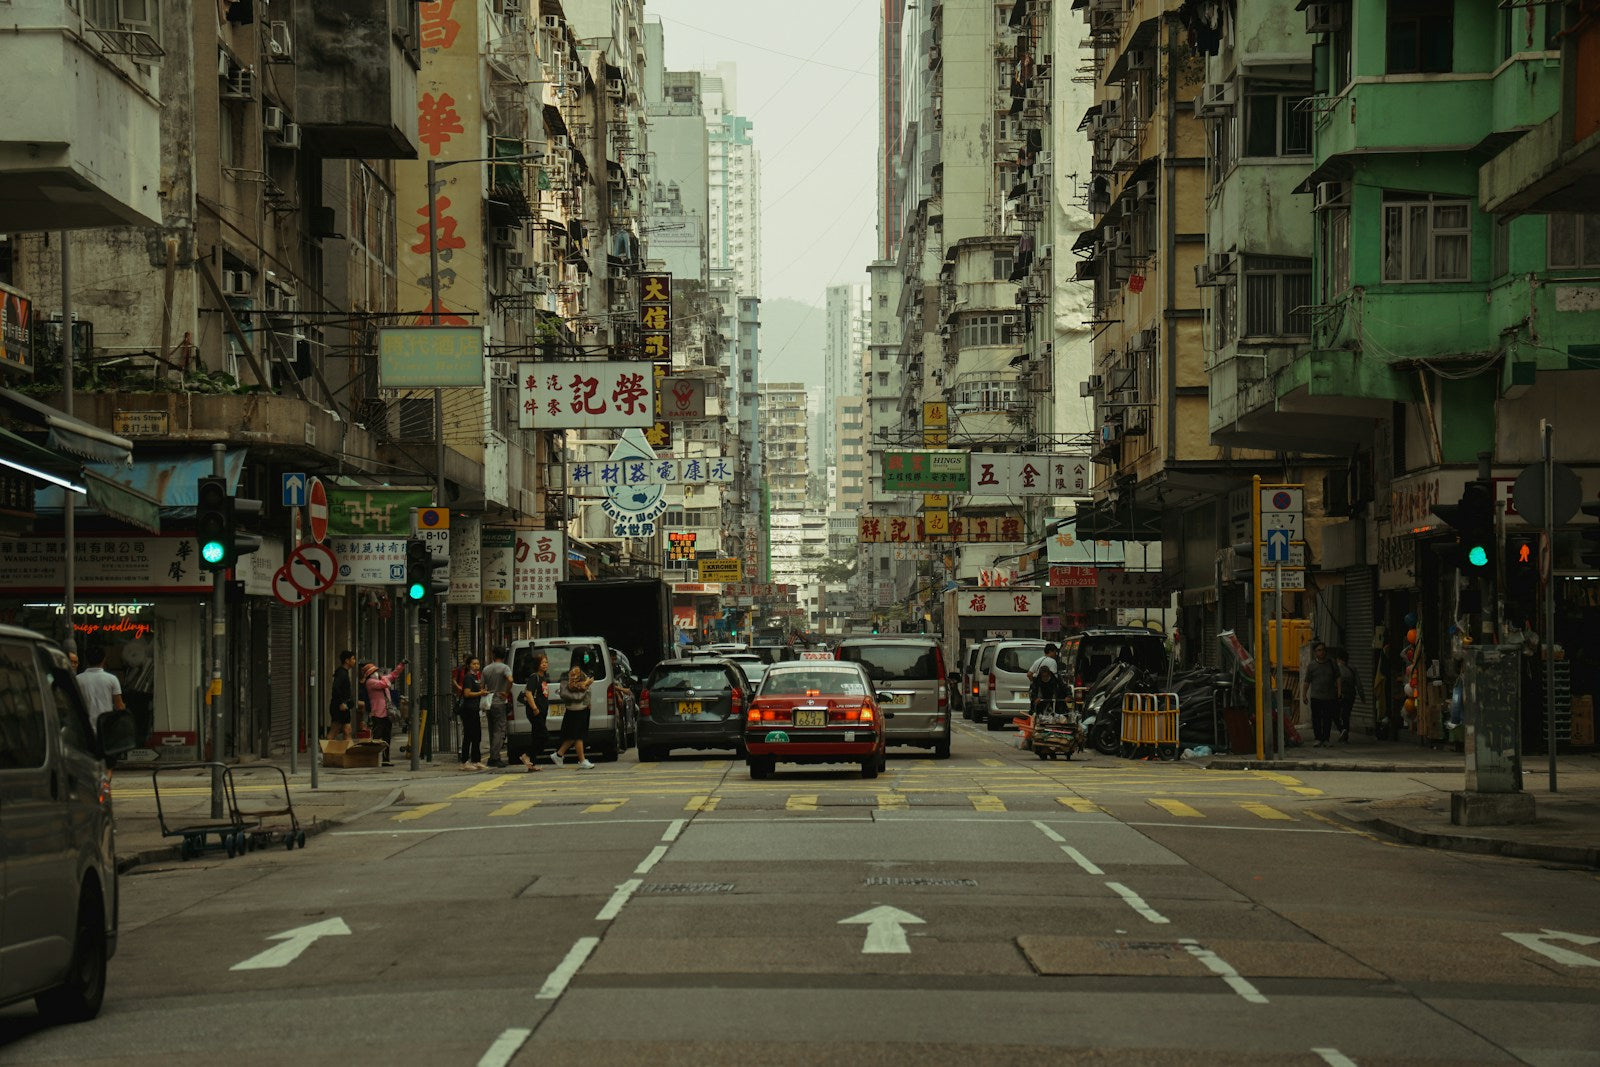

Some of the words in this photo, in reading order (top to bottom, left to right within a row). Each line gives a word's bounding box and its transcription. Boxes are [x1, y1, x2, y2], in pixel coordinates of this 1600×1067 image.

[601, 500, 633, 523] Water
[636, 499, 667, 524] World
[426, 531, 448, 540] 8-10
[614, 523, 655, 537] 水世界
[426, 545, 443, 554] 5-7
[108, 604, 142, 617] tiger
